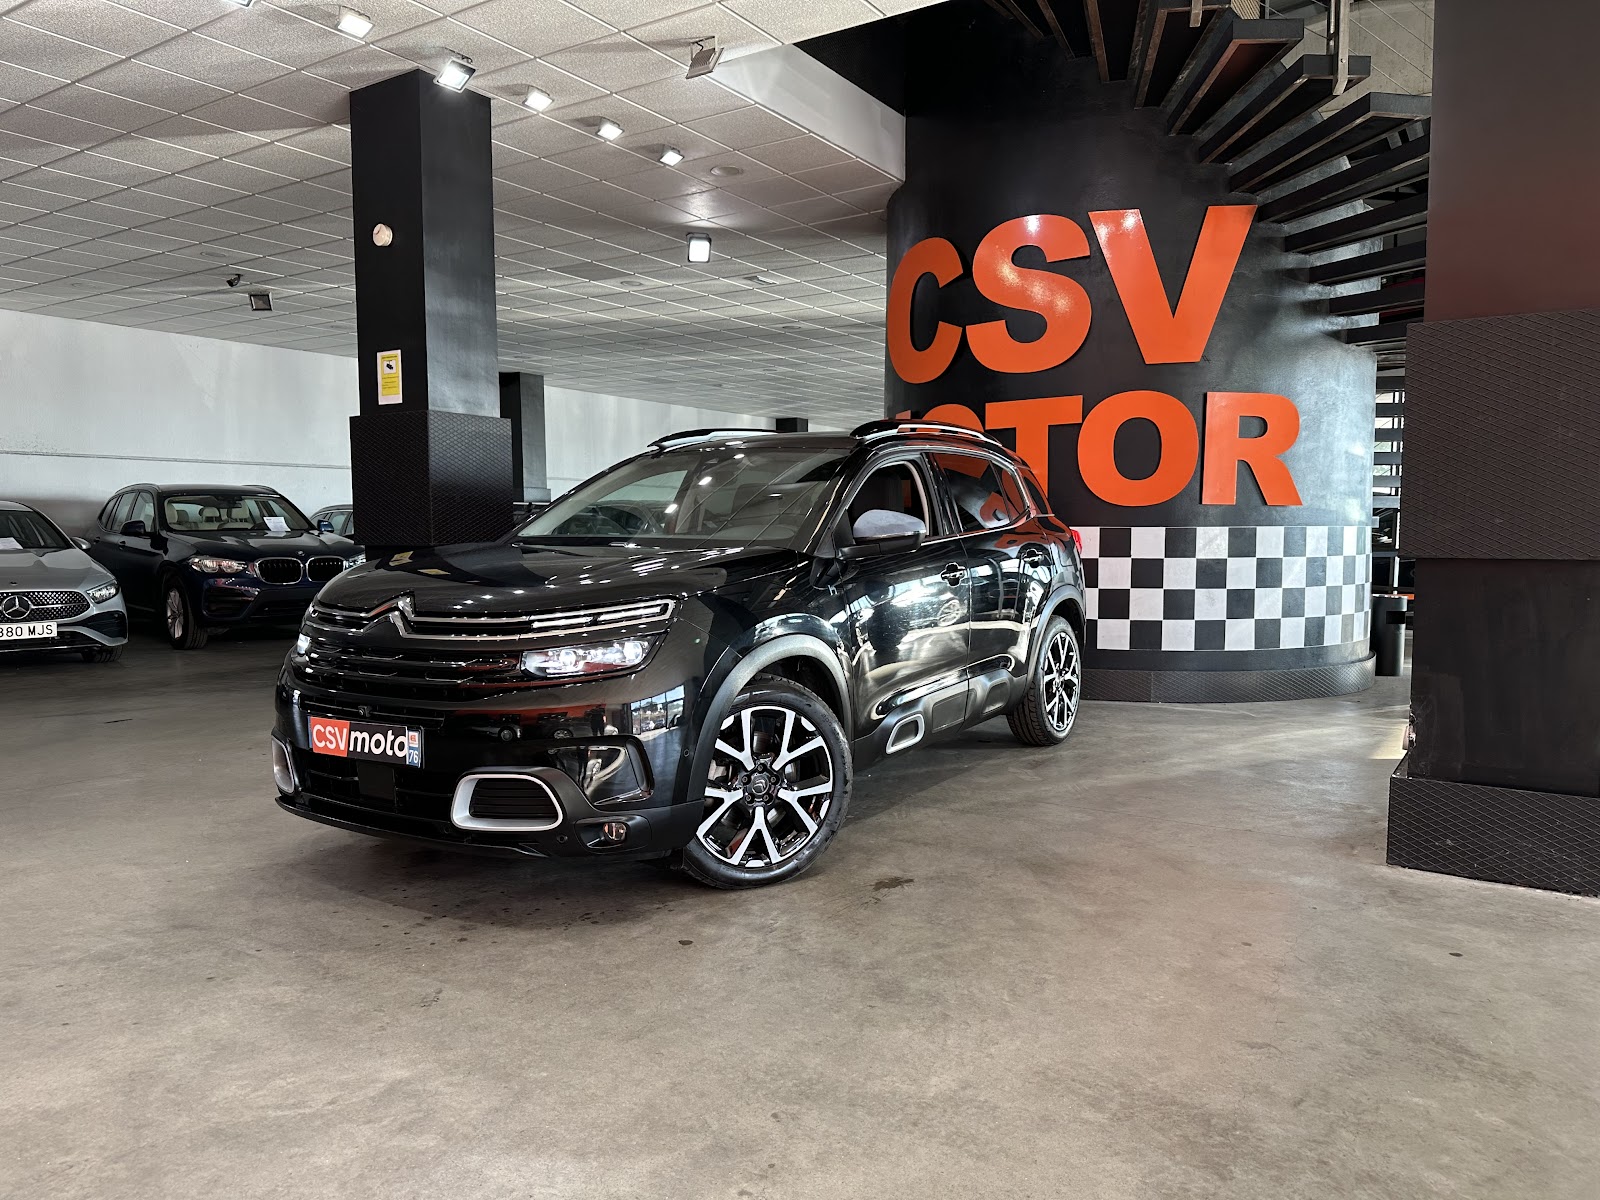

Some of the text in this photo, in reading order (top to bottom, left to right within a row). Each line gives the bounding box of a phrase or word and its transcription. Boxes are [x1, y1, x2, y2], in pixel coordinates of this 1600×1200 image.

[888, 204, 1258, 384] CSV
[886, 390, 1304, 507] TOR
[28, 624, 53, 637] MJS
[409, 749, 419, 763] 76
